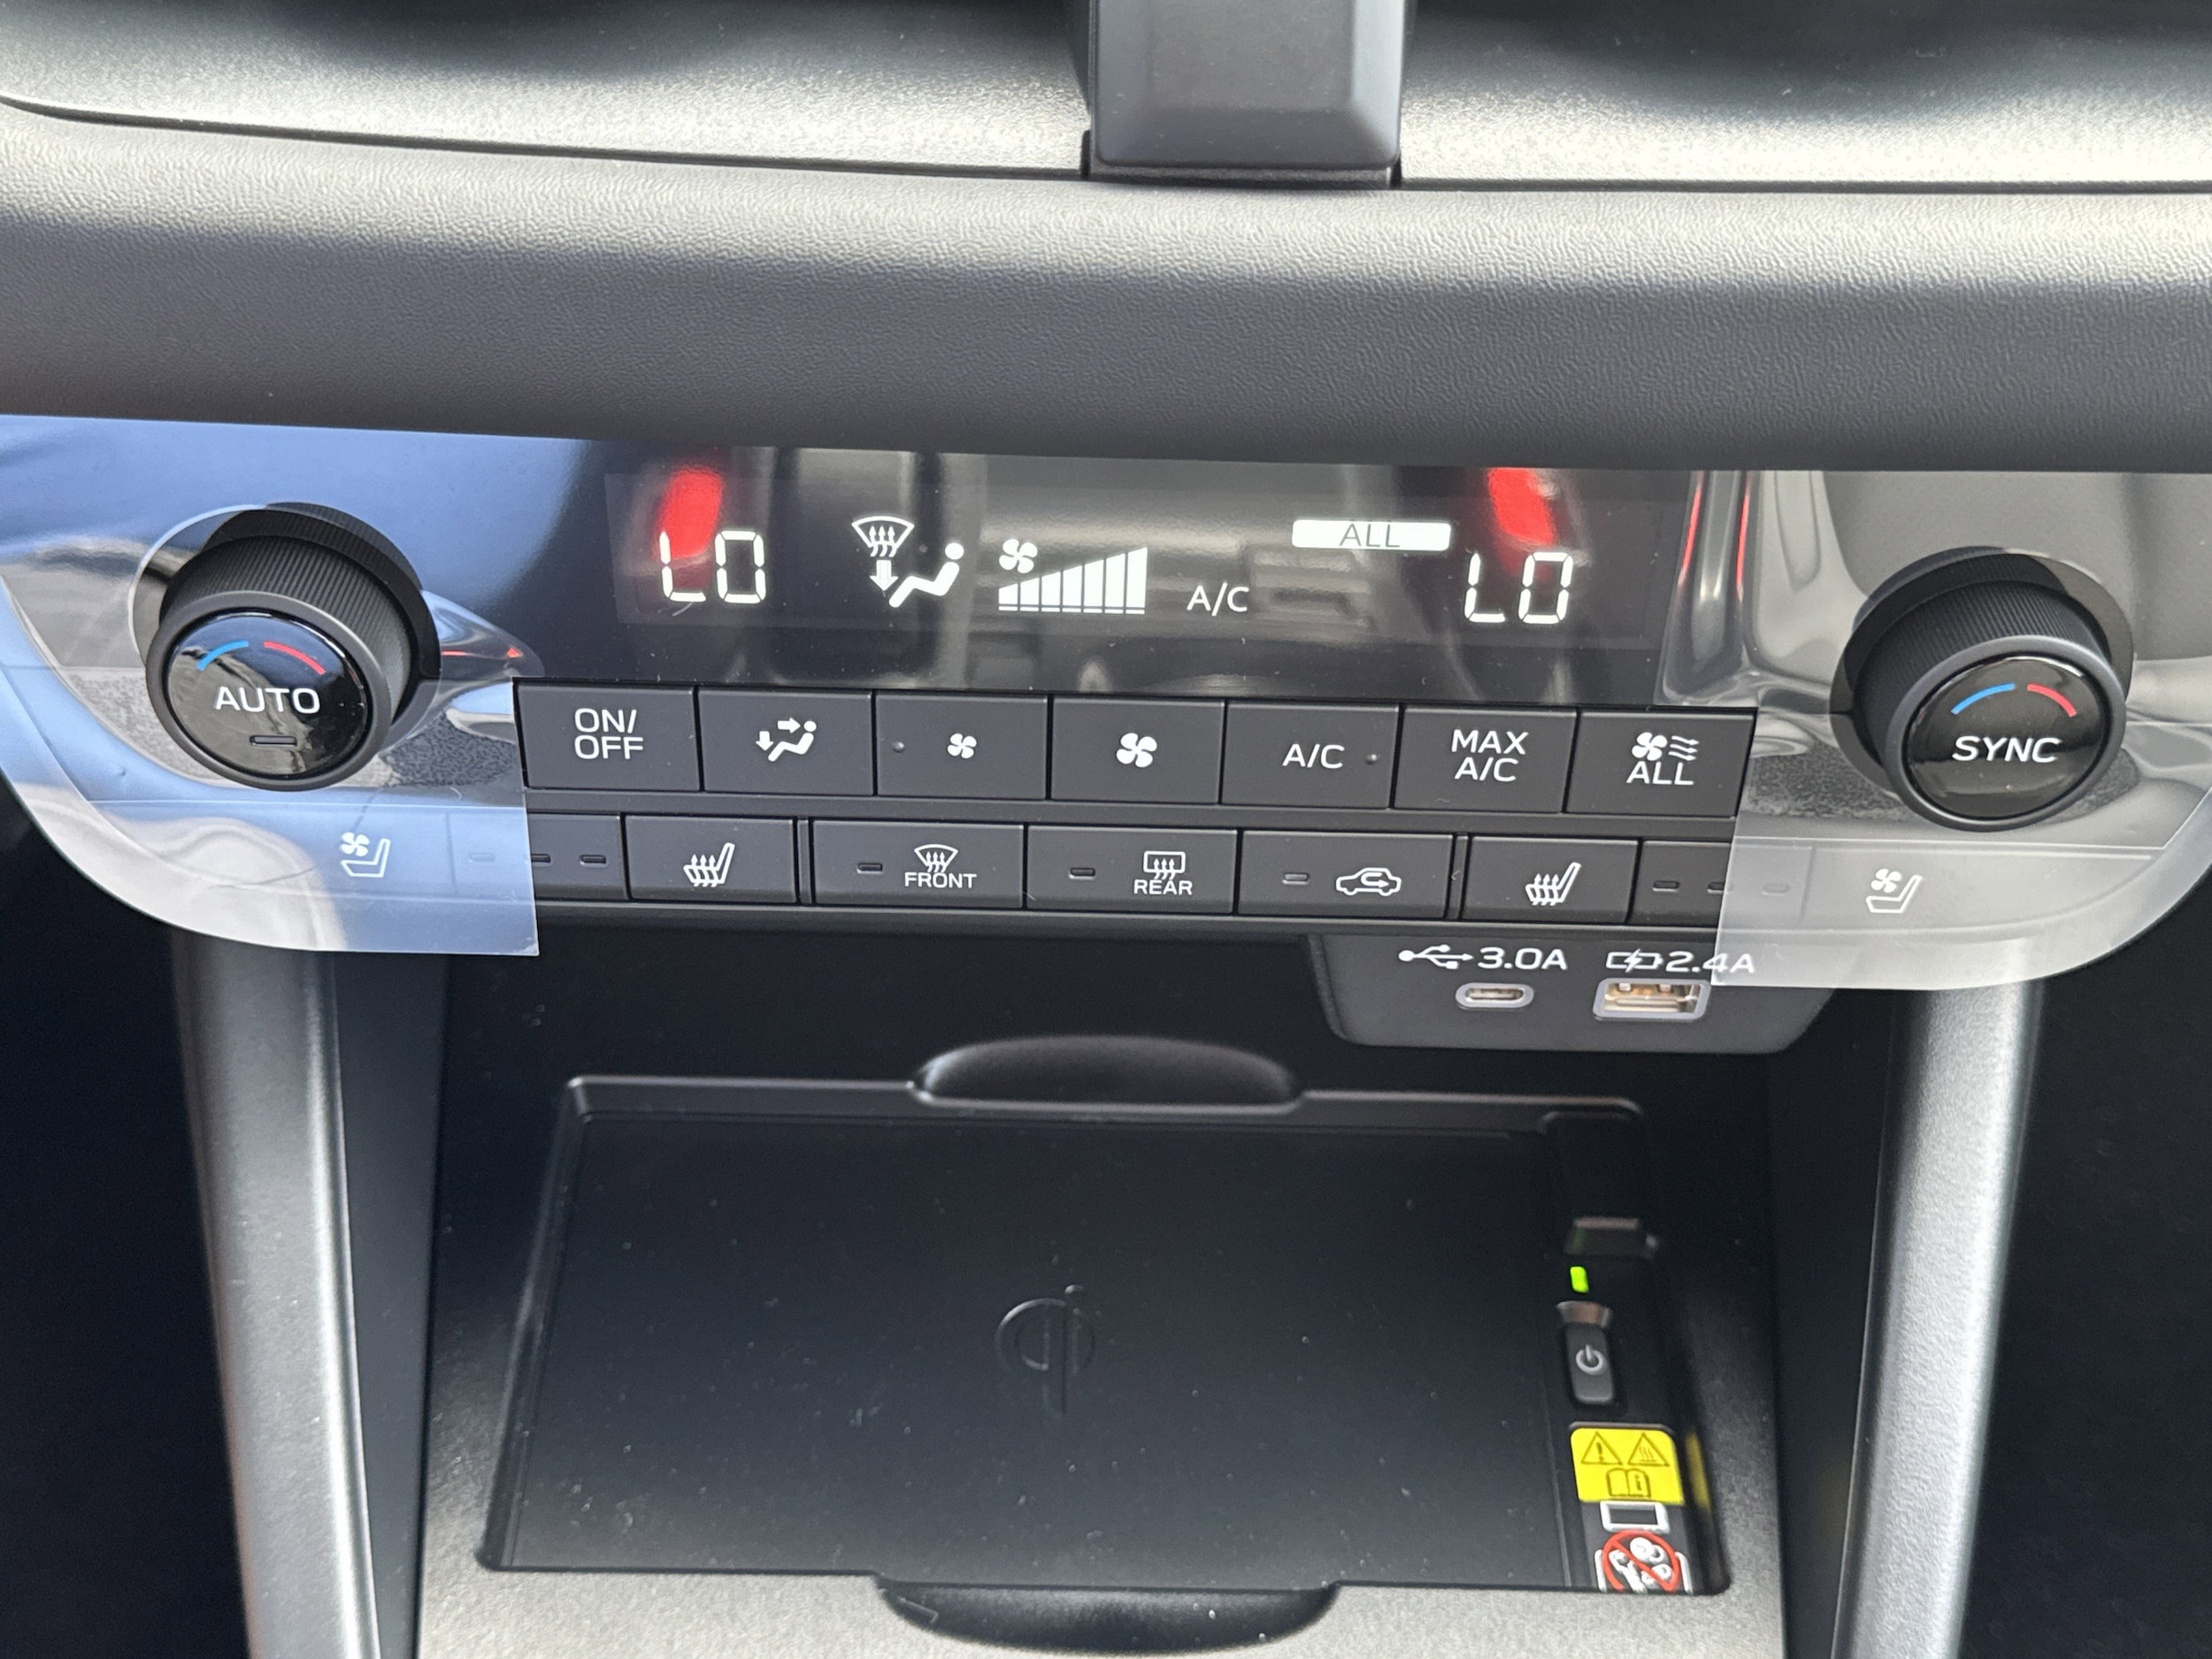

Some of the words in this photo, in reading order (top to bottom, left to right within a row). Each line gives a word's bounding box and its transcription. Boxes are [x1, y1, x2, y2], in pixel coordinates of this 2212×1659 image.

[1339, 521, 1402, 550] ALL
[1187, 584, 1250, 616] A/C
[214, 687, 321, 715] AUTO
[574, 708, 638, 734] ON/
[573, 736, 644, 761] OFF
[1451, 730, 1528, 756] MAX
[1952, 736, 2062, 764] SYNC
[1282, 744, 1345, 771] A/C
[1454, 757, 1518, 783] A/C
[1626, 760, 1694, 787] ALL
[904, 872, 978, 890] FRONT
[1133, 879, 1194, 896] REAR
[1477, 947, 1568, 972] 3.0A
[1665, 951, 1755, 974] 2.4A
